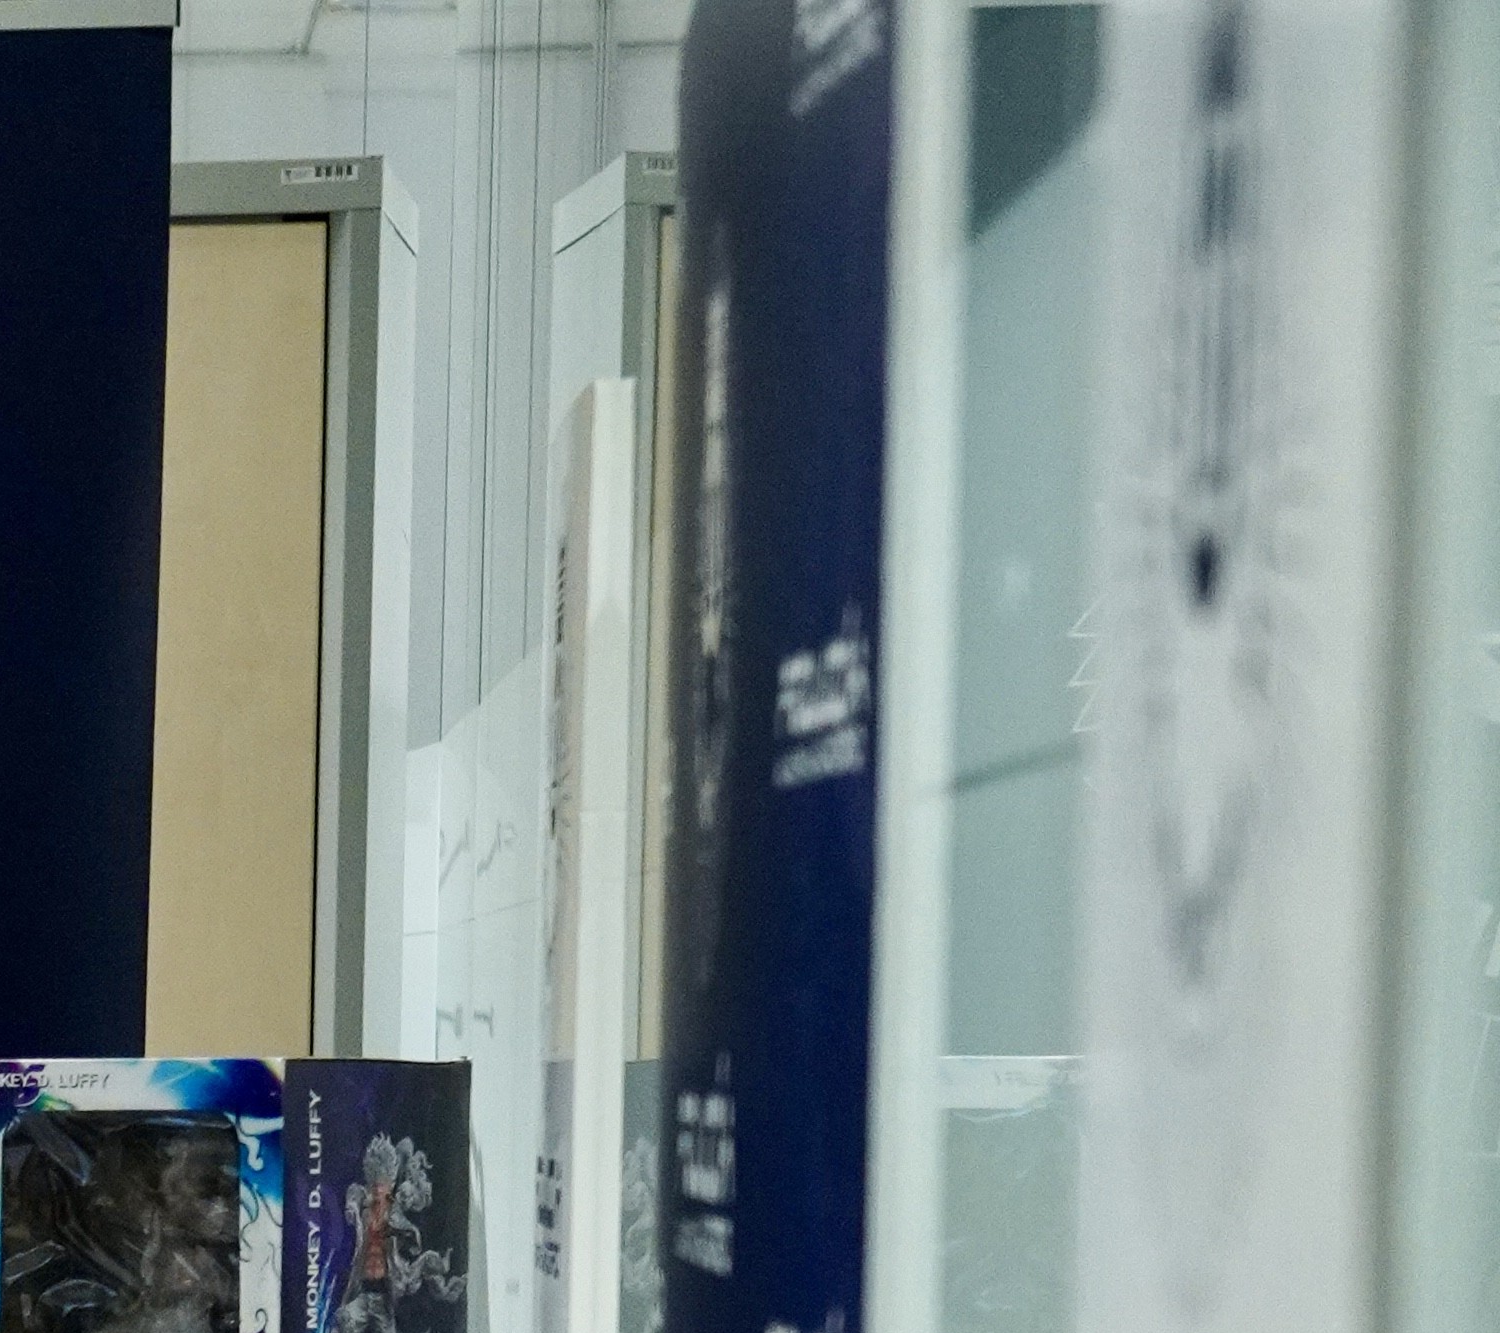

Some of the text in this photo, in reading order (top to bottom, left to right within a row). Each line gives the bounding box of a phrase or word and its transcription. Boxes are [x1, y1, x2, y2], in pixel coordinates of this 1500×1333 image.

[58, 1071, 111, 1089] LUFFY
[307, 1086, 323, 1180] LUFFY
[306, 1221, 321, 1331] MONKEY
